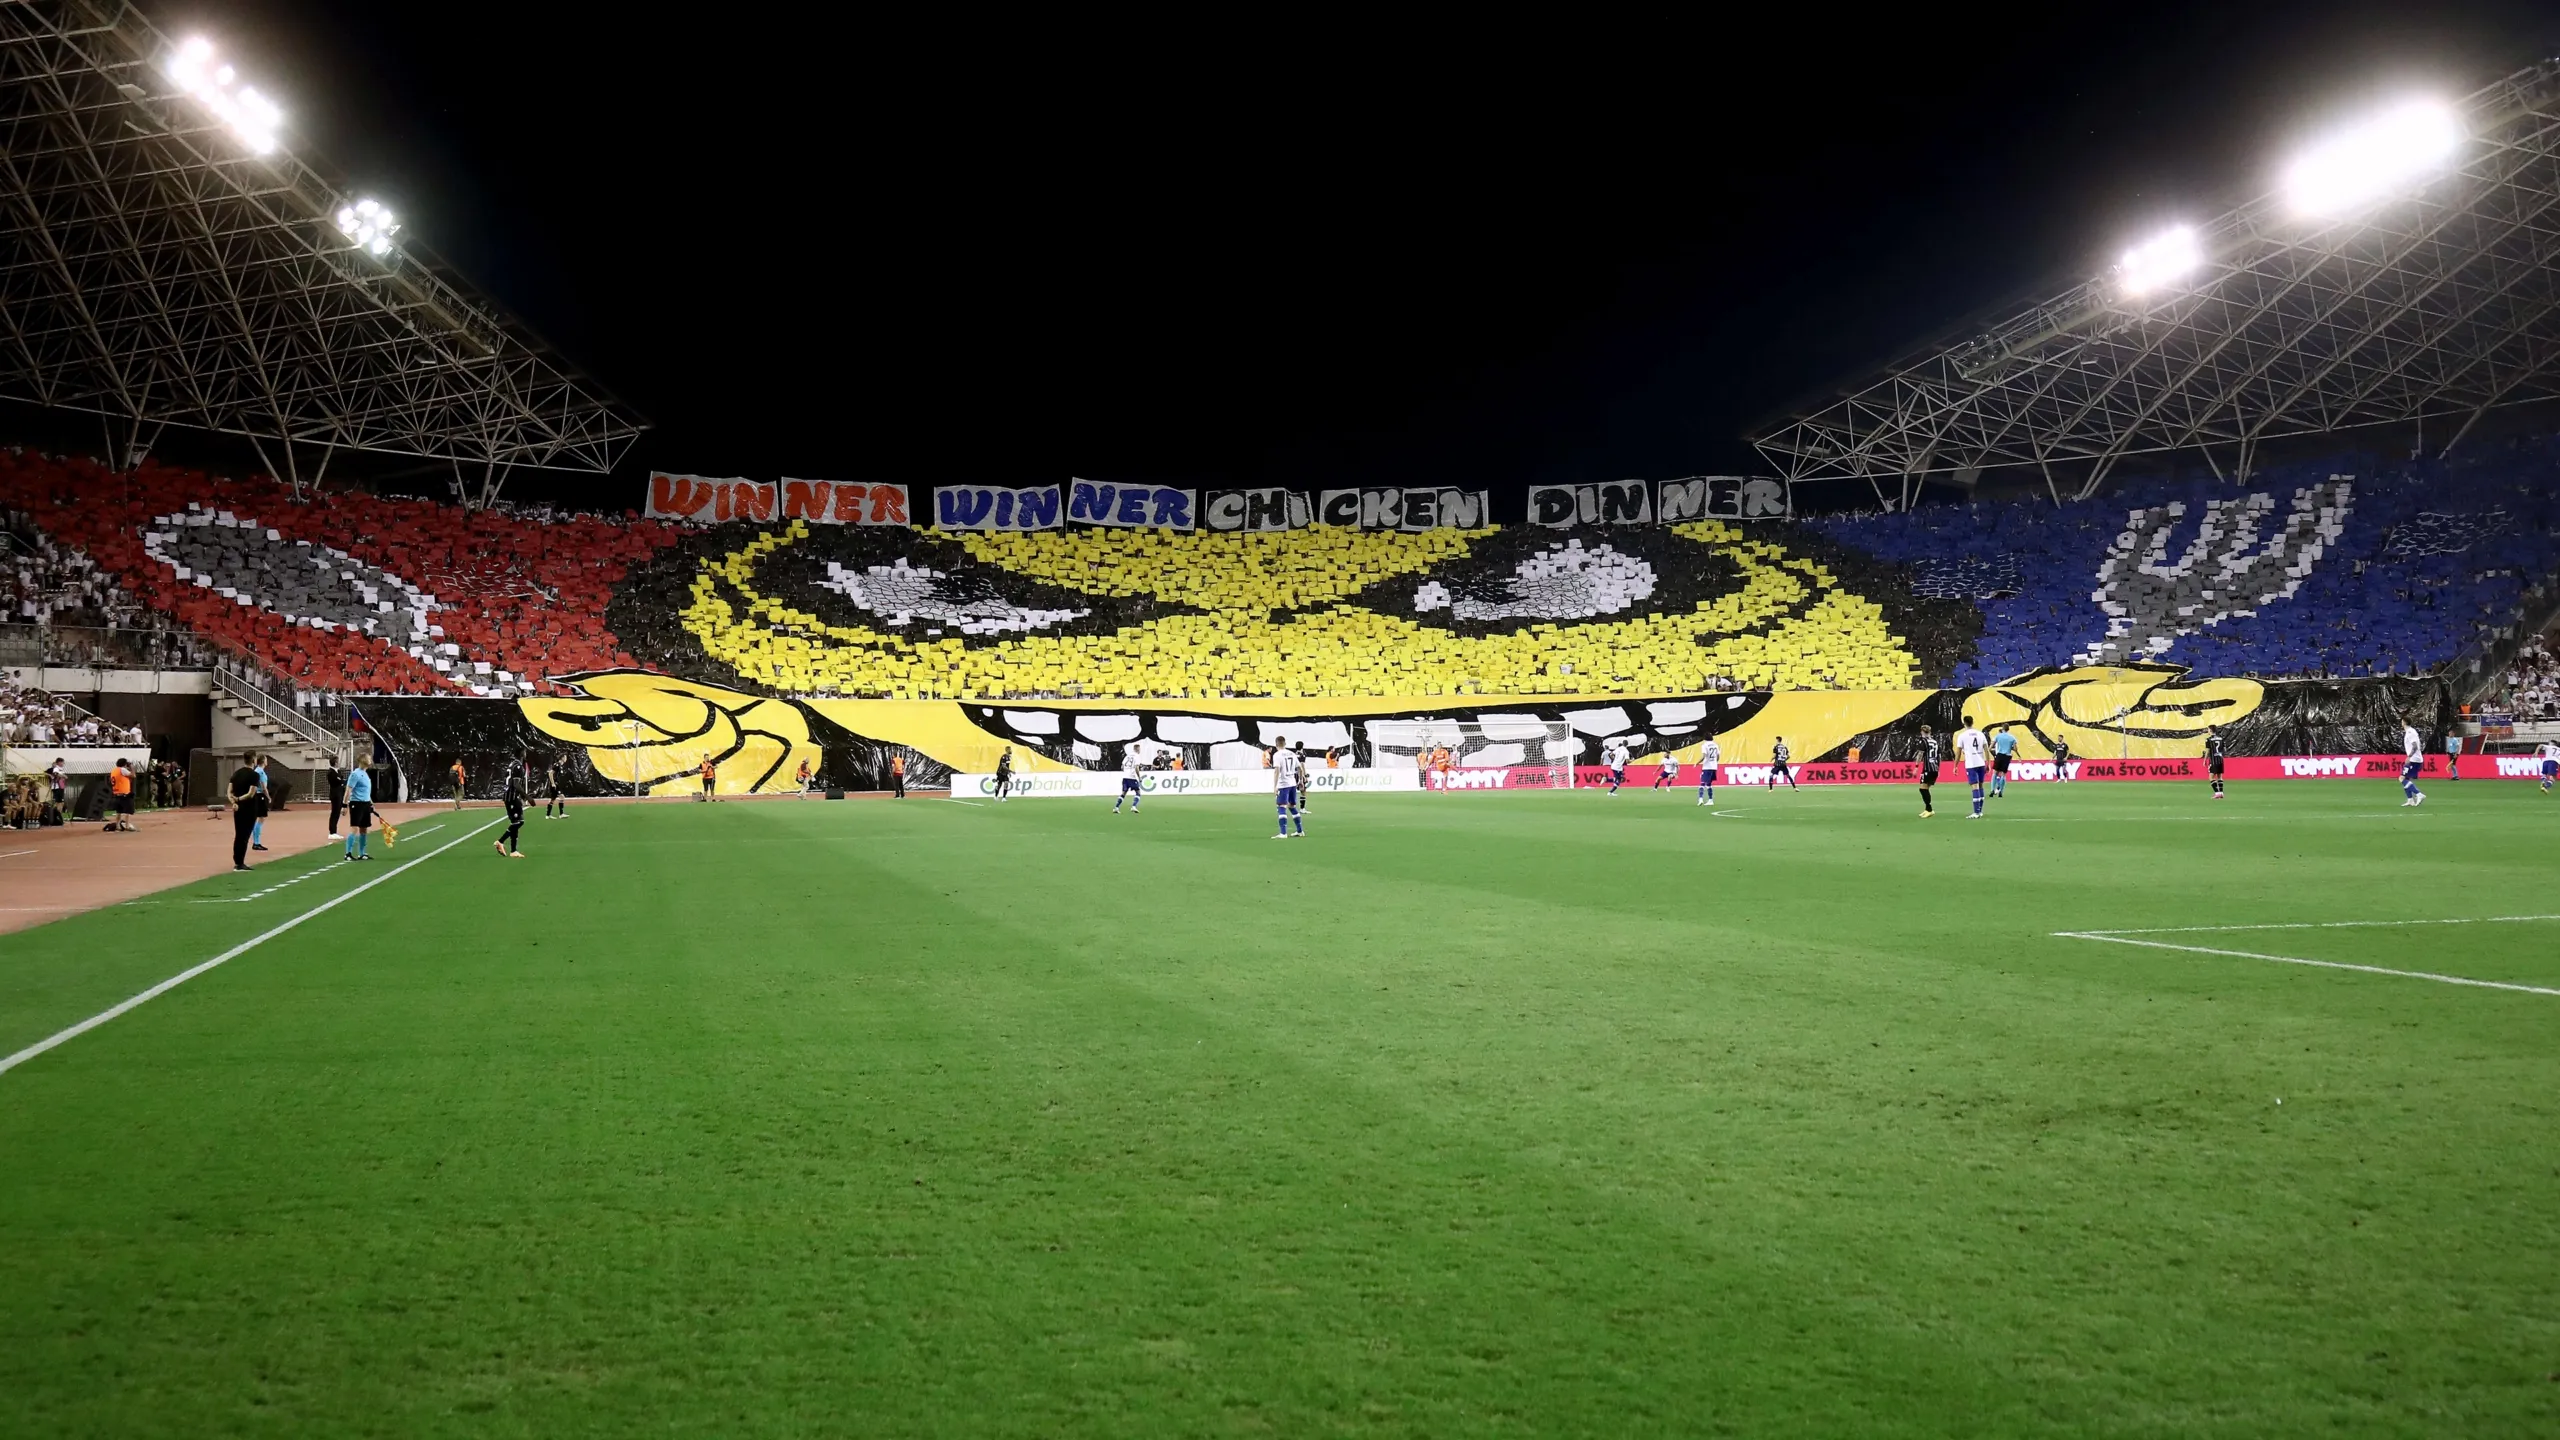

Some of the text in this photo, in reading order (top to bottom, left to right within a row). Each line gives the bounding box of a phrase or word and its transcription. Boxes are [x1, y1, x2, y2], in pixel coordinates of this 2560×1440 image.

[1971, 737, 1979, 750] 4
[1284, 757, 1293, 773] 17
[2087, 766, 2115, 776] ZNA
[2118, 762, 2146, 776] ŠTO
[2150, 761, 2193, 776] VOLIŠ.
[2281, 757, 2361, 776] TOMMY
[2366, 761, 2389, 772] ZNA
[1806, 770, 1836, 780] ZNA
[1840, 766, 1868, 780] ŠTO
